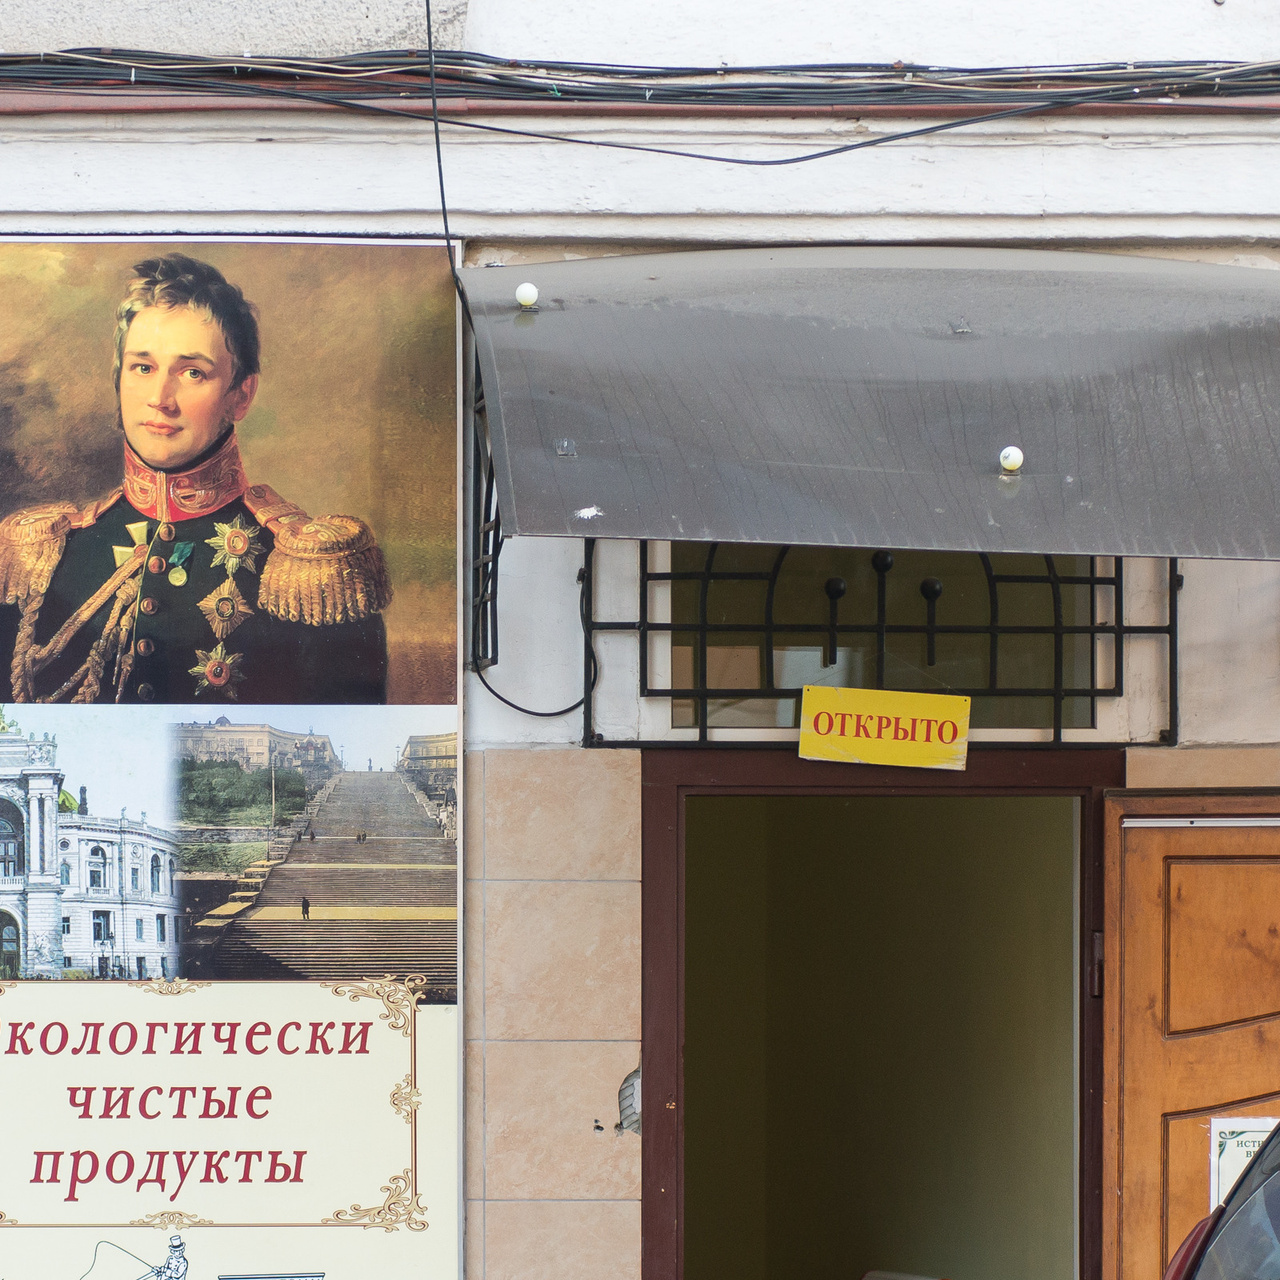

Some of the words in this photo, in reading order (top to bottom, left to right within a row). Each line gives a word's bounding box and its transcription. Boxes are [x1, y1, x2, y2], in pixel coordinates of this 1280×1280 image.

[813, 711, 958, 744] ОТКРЫТО
[67, 1085, 272, 1120] чистые
[30, 1150, 307, 1202] продукты
